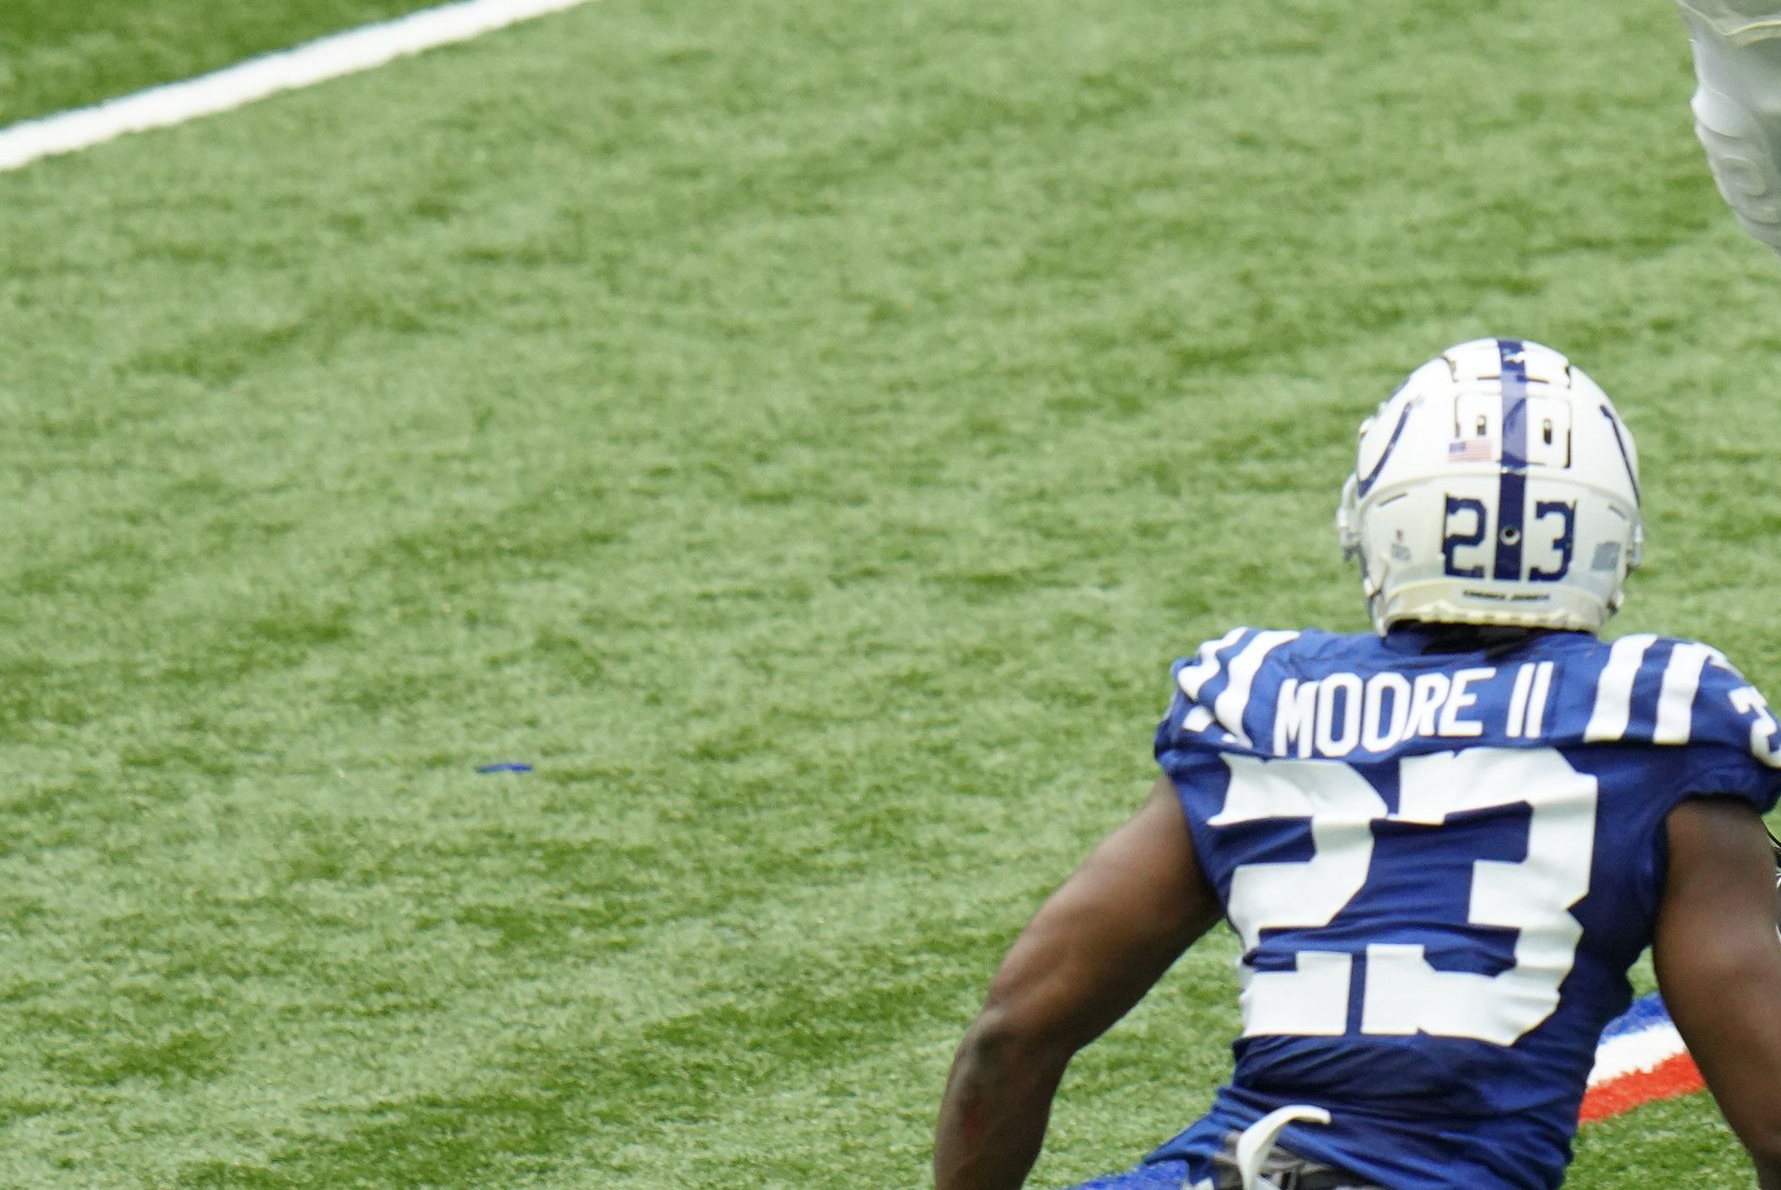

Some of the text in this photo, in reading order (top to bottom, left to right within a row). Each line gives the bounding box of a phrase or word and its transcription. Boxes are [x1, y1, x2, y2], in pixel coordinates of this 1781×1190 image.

[1442, 493, 1577, 582] 23
[1274, 661, 1555, 758] MOORE II
[1207, 747, 1598, 1046] 23
